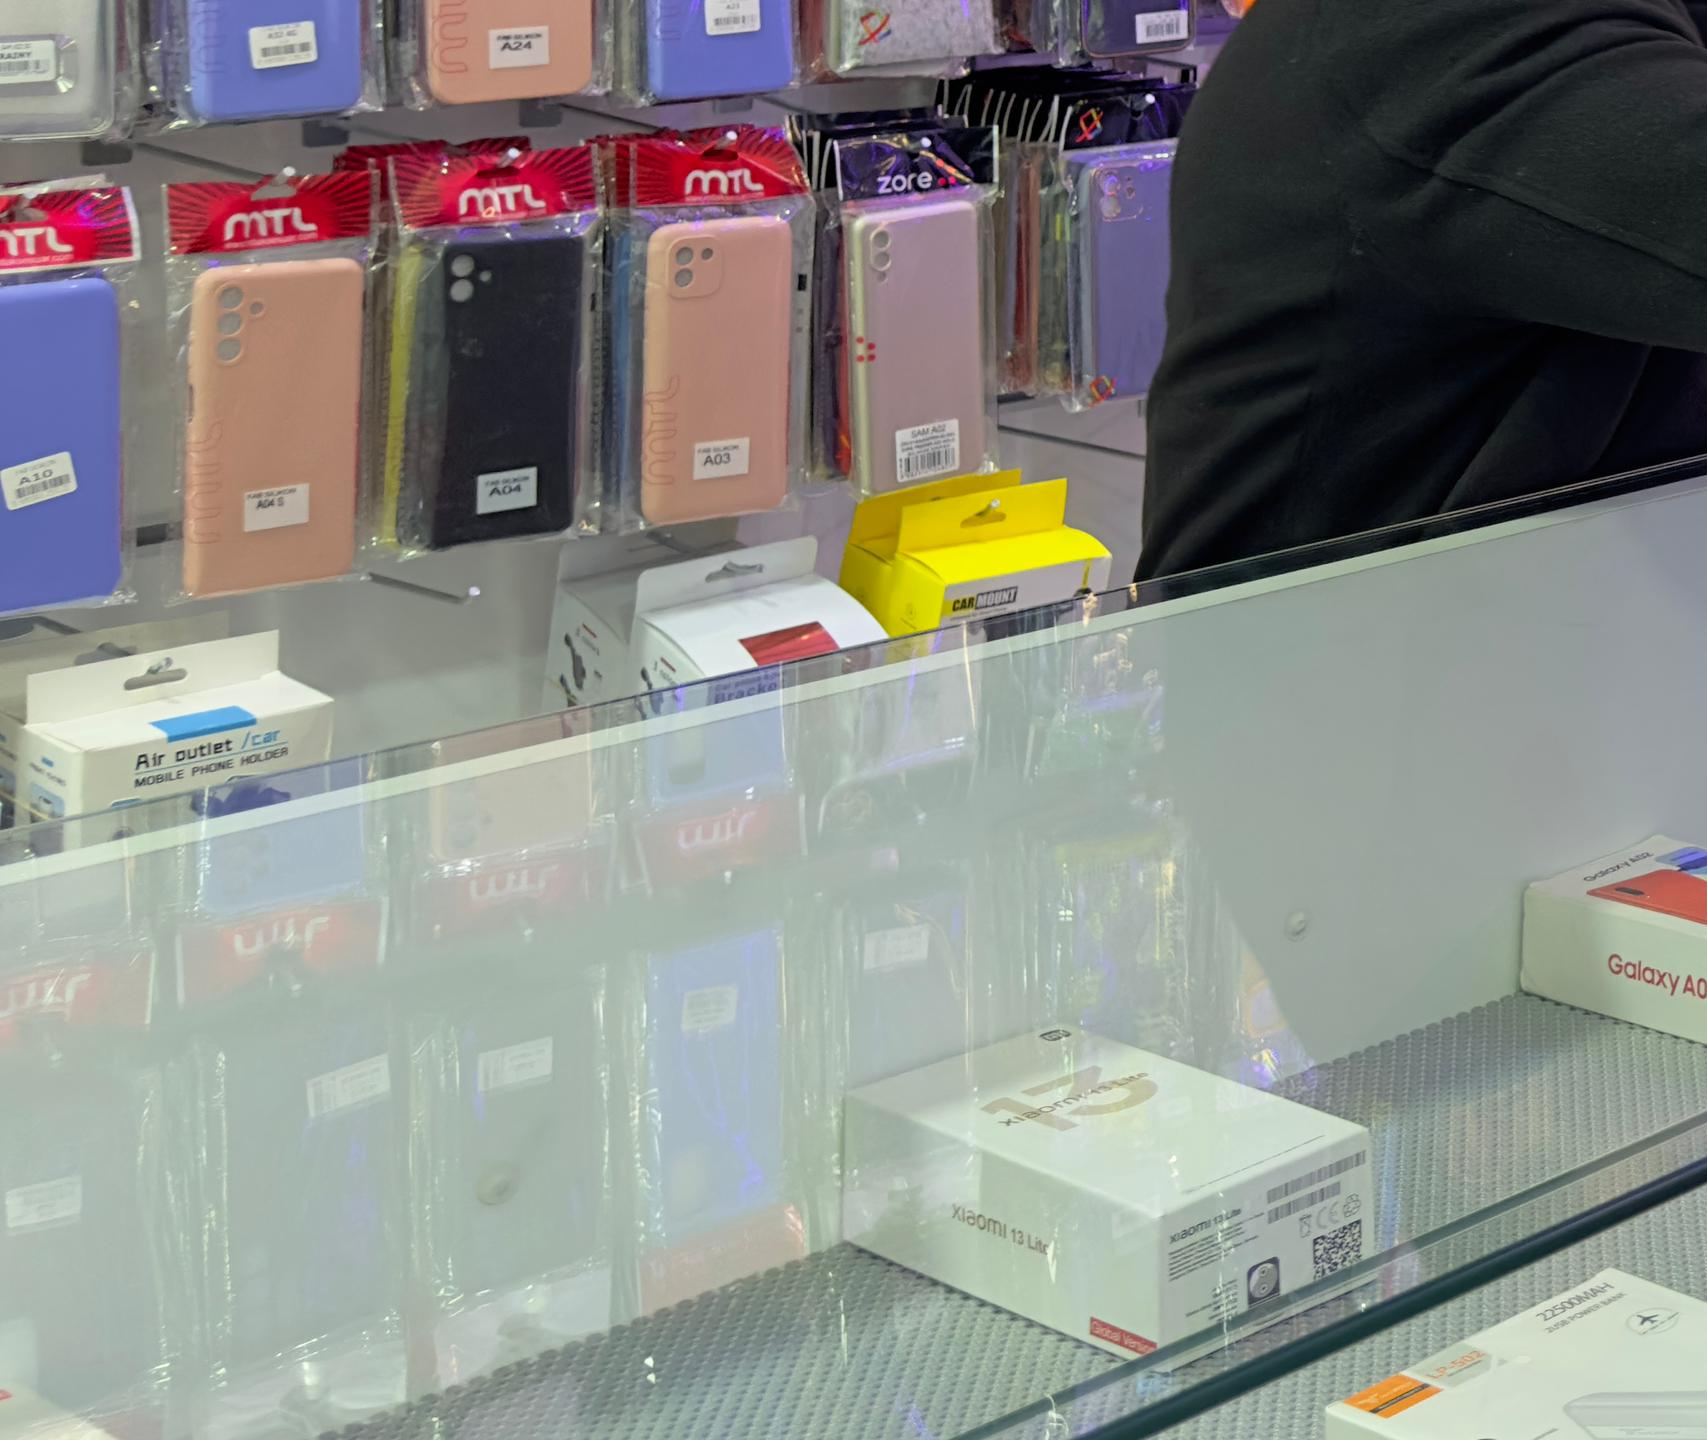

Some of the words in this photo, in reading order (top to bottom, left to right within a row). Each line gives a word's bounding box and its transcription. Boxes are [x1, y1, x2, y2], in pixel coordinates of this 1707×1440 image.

[501, 40, 533, 51] A24
[685, 167, 764, 195] MTL
[877, 170, 932, 194] zore
[458, 182, 547, 217] MTL
[224, 207, 318, 242] MTL
[703, 453, 732, 467] A03
[18, 469, 54, 486] A10
[489, 483, 522, 497] A04
[952, 597, 975, 612] CAR
[977, 587, 1017, 610] MOUNT
[134, 769, 184, 788] MOBILE
[192, 758, 234, 776] PHONE
[240, 747, 289, 766] HOLDER
[135, 753, 166, 771] Air
[175, 738, 233, 762] outlet
[1583, 861, 1630, 882] Galaxy
[1629, 851, 1655, 866] A02
[1607, 953, 1680, 997] Galaxy
[1011, 1228, 1025, 1246] 13
[1536, 1281, 1616, 1322] 22500MAH
[1568, 1304, 1599, 1323] POWER
[1600, 1291, 1628, 1308] BANK
[1091, 1320, 1122, 1341] Global
[1426, 1349, 1488, 1380] LP-502
